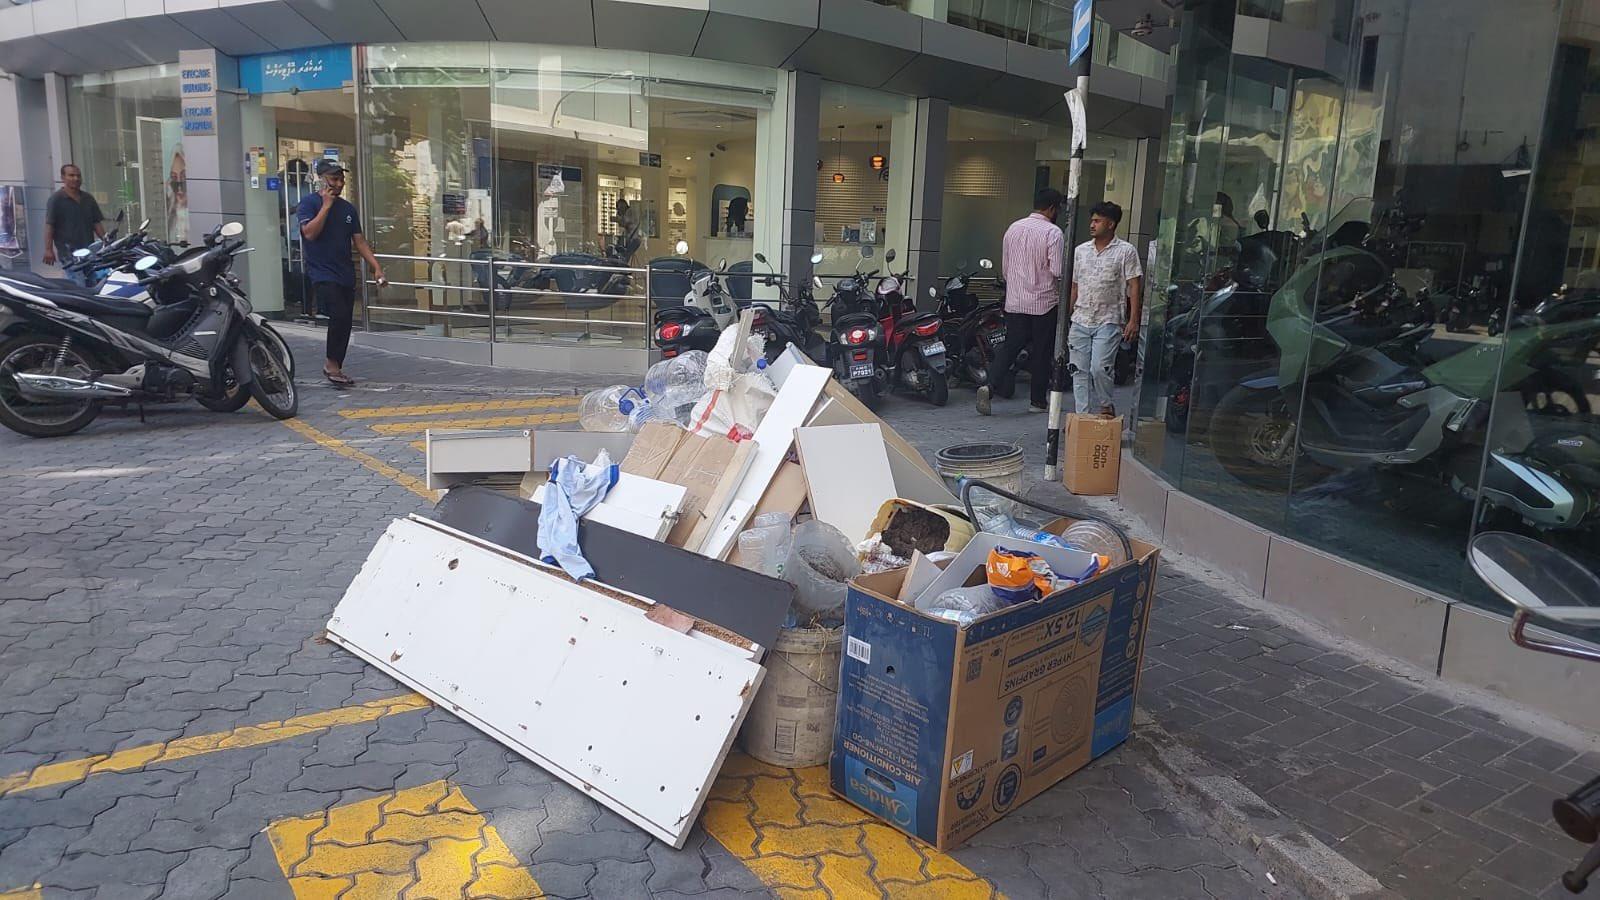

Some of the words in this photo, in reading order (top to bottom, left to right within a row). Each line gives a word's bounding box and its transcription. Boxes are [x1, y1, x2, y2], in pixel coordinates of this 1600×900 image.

[1093, 444, 1101, 469] aqua
[1046, 651, 1073, 671] HYPER
[843, 739, 921, 786] AIR-CONDITIONER
[850, 776, 912, 826] Midea
